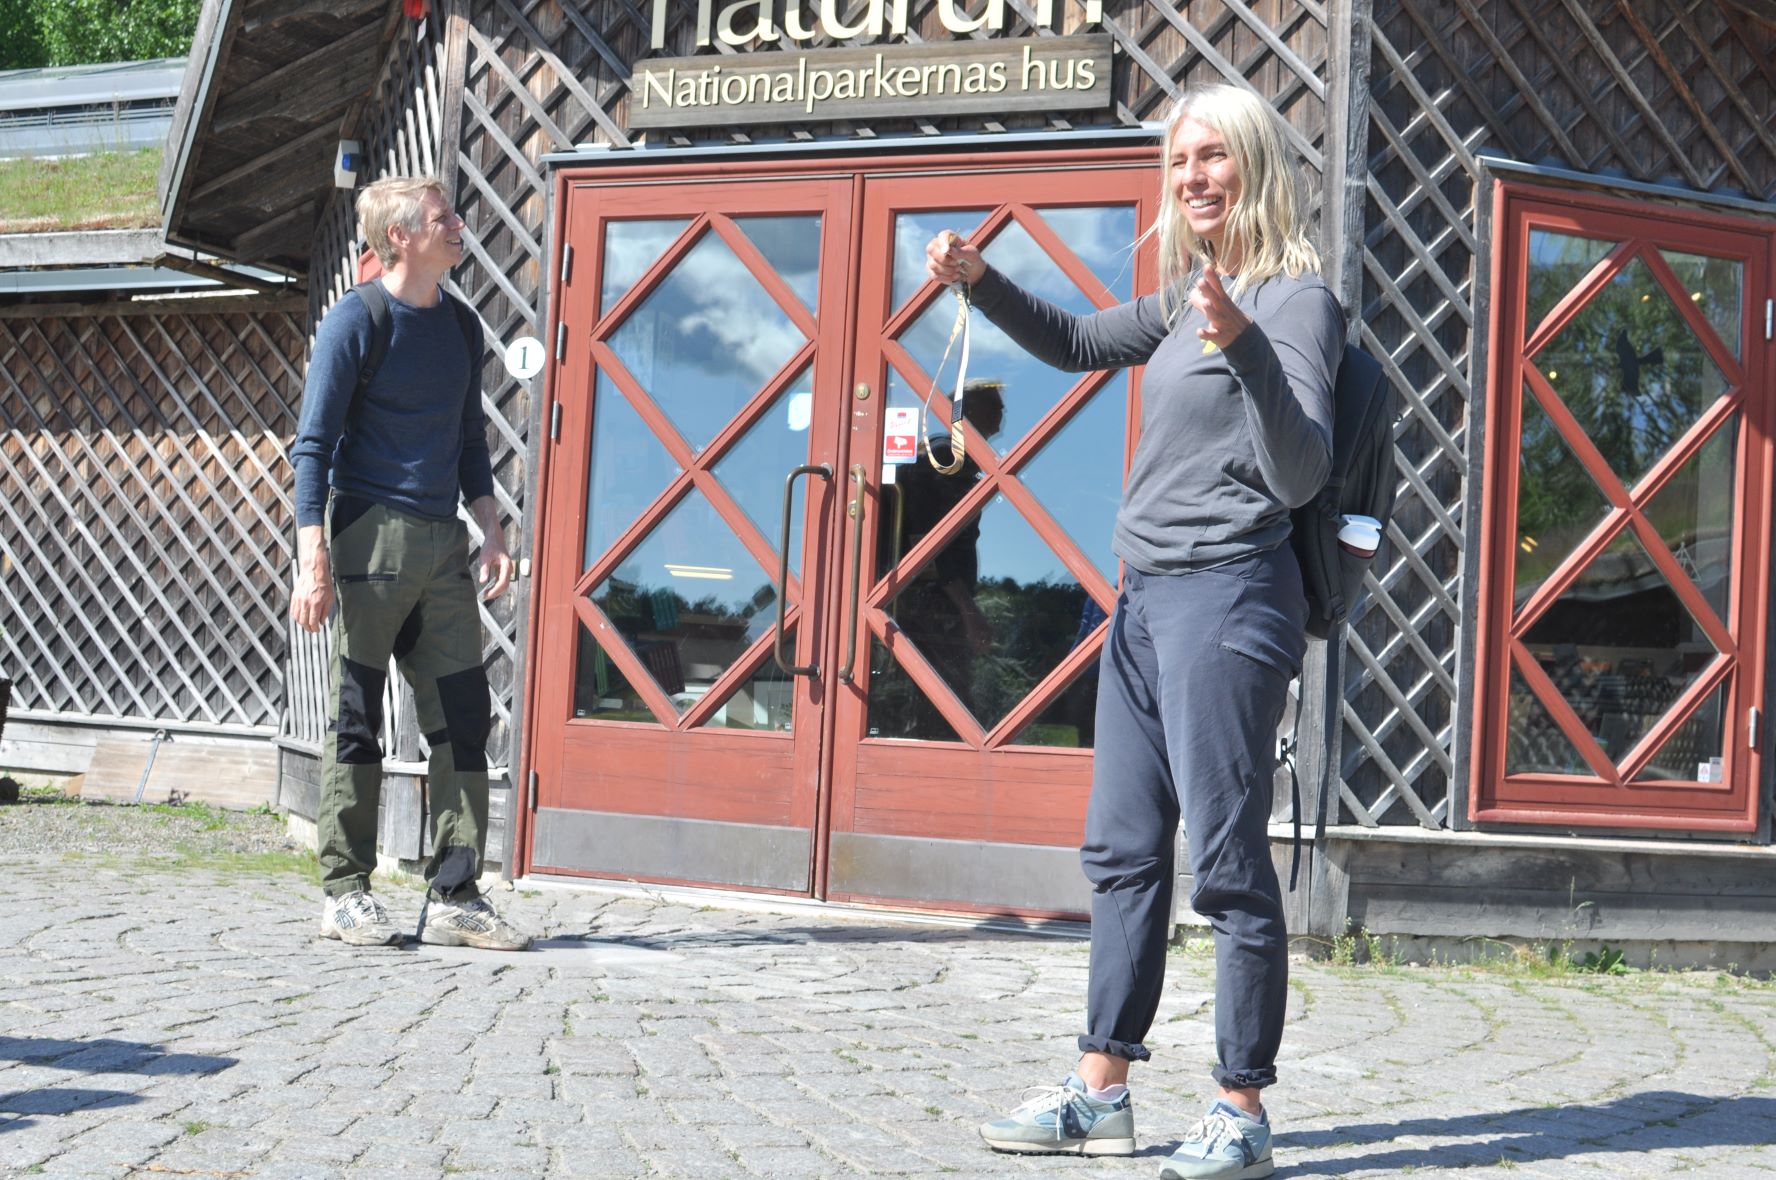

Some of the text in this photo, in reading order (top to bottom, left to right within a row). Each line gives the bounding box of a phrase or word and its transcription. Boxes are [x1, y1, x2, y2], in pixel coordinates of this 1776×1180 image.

[642, 45, 1097, 113] Nationalparkernas hus
[518, 345, 530, 370] 1
